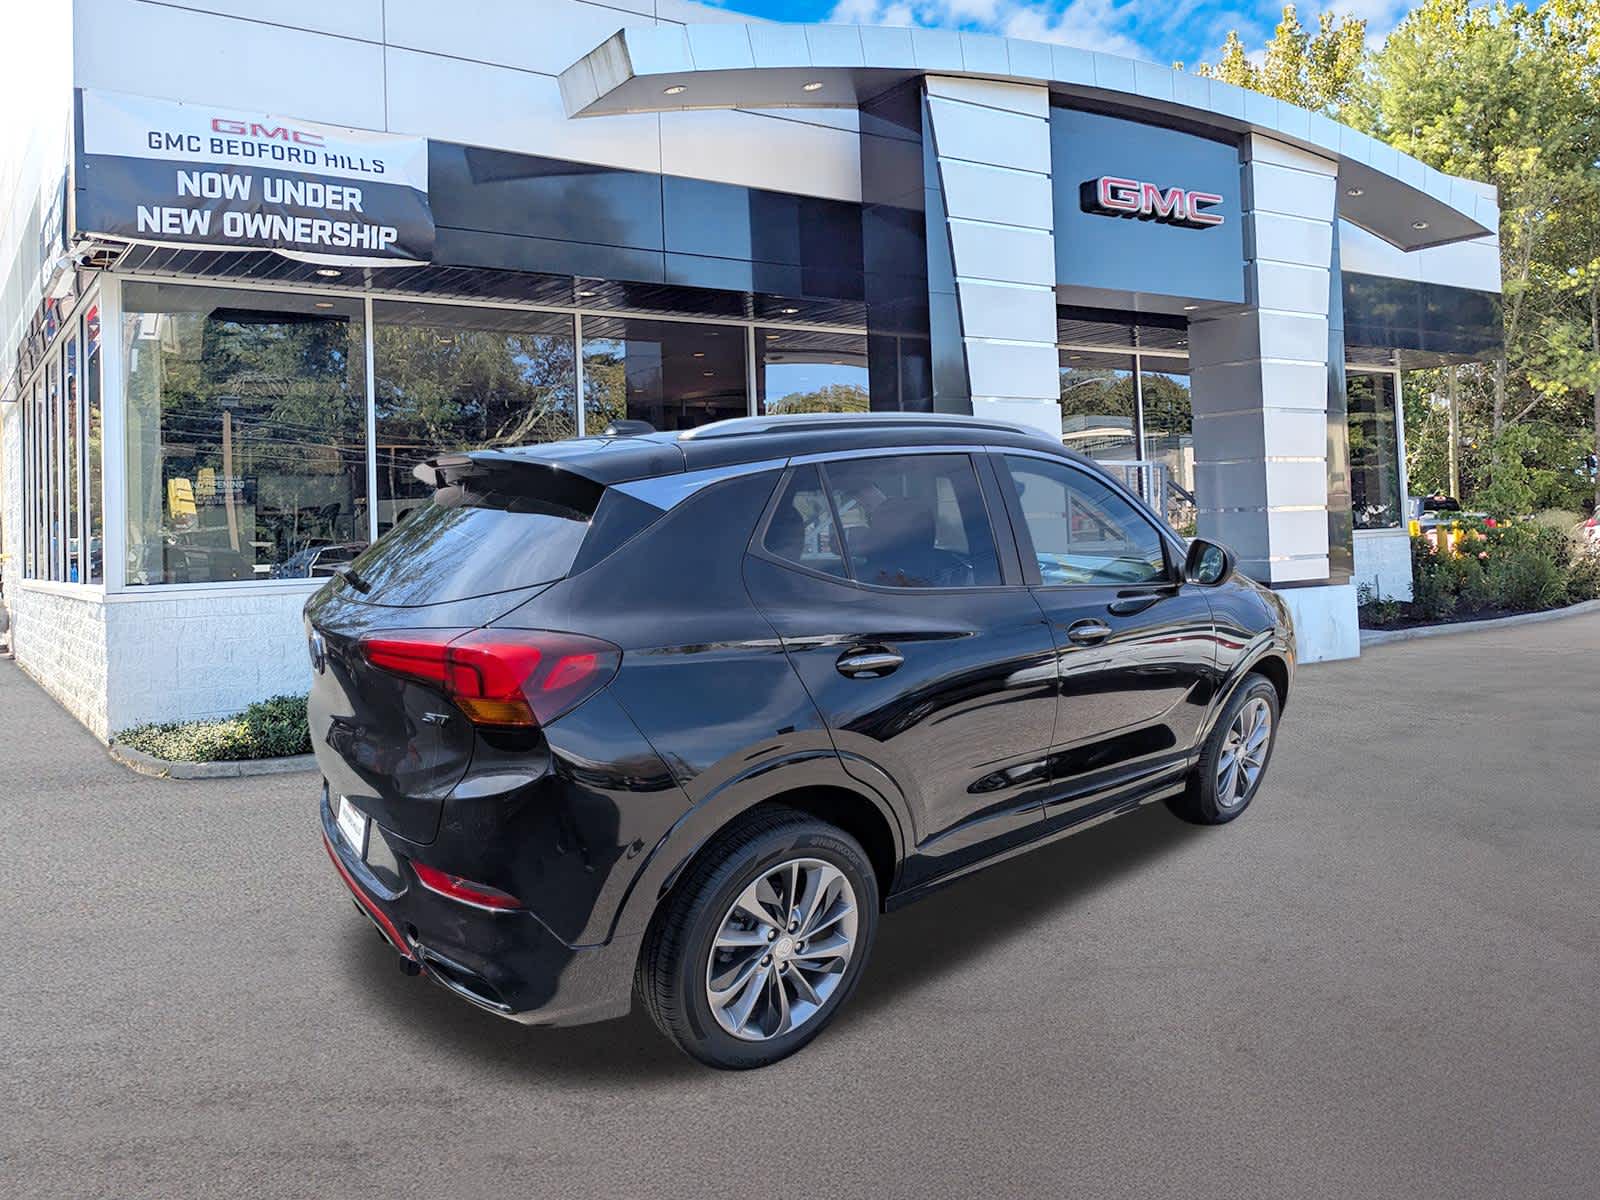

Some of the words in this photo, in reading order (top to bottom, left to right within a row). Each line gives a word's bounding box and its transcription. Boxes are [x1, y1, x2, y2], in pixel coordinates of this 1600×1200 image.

[148, 131, 201, 153] GMC
[210, 138, 317, 166] BEDFORD
[325, 153, 385, 175] HILLS
[211, 117, 326, 148] GMC
[177, 170, 252, 202] NOW
[263, 176, 364, 214] UNDER
[1097, 175, 1225, 225] GMC
[136, 205, 212, 237] NEW
[223, 210, 398, 251] OWNERSHIP
